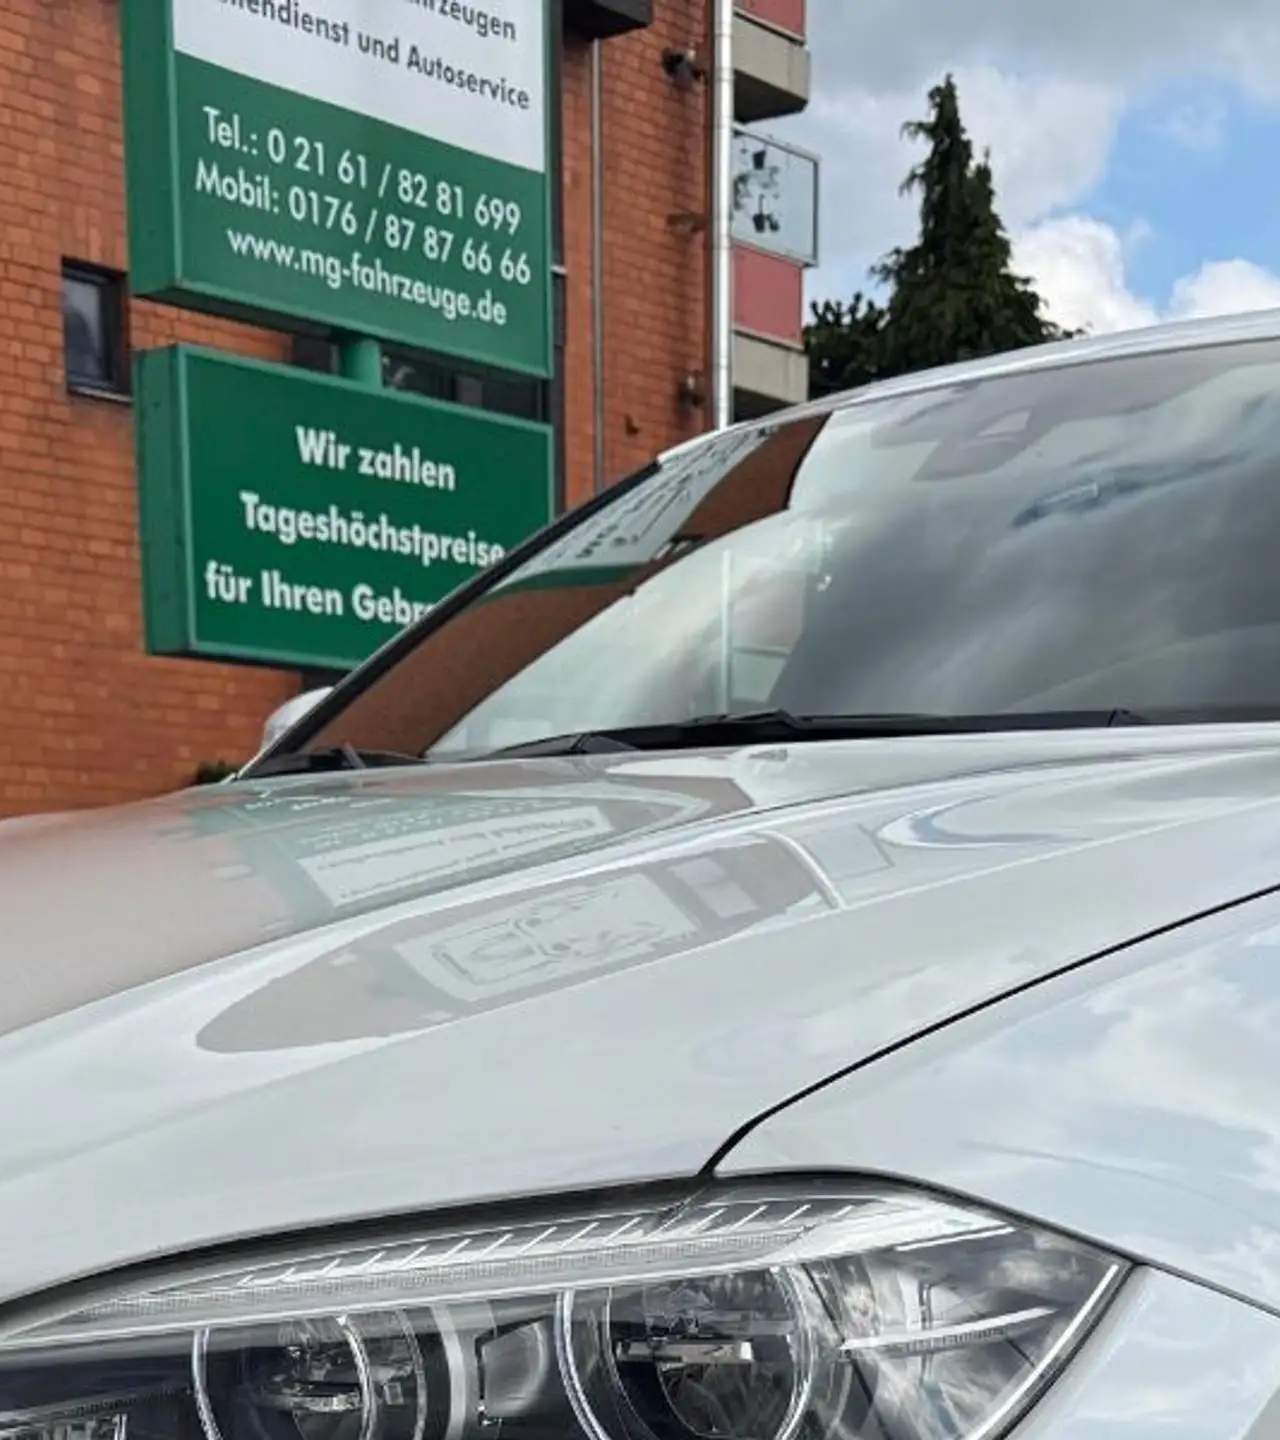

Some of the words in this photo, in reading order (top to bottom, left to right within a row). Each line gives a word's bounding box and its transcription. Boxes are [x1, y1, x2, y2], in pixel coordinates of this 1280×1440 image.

[357, 31, 400, 65] und
[406, 44, 530, 109] Autoservice
[203, 105, 259, 156] Tel.:
[267, 129, 286, 164] 0
[293, 136, 326, 175] 21
[337, 150, 369, 188] 61
[377, 163, 392, 198] /
[398, 169, 428, 208] 82
[436, 182, 464, 218] 81
[473, 193, 522, 237] 699
[195, 158, 280, 215] Mobil:
[288, 186, 358, 237] 0176
[364, 209, 378, 243] /
[384, 215, 416, 252] 87
[423, 227, 454, 263] 87
[461, 237, 492, 275] 66
[500, 248, 532, 285] 66
[227, 228, 507, 327] www.mg-fahrzeuge.de
[295, 425, 351, 471] Wir
[358, 442, 456, 491] zahlen
[239, 490, 505, 568] Tageshöchstpreise
[204, 560, 252, 603] für
[261, 570, 343, 616] Ihren
